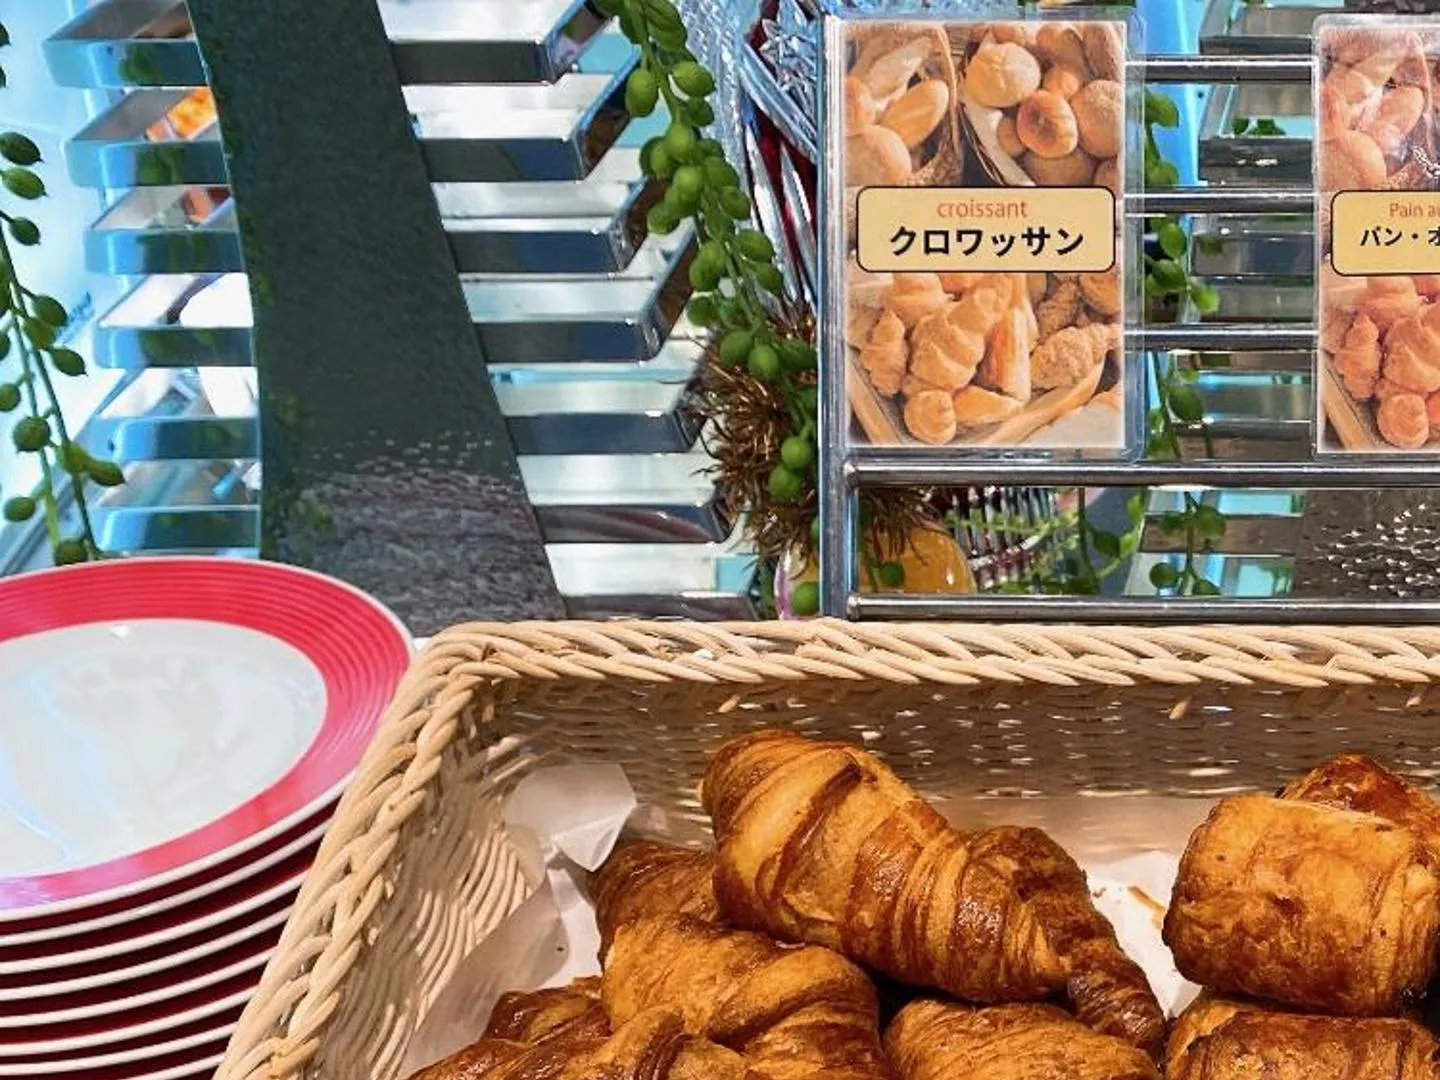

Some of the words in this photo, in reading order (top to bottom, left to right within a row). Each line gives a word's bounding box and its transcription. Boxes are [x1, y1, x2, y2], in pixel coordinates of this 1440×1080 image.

[937, 199, 1028, 218] croissant
[1389, 202, 1424, 218] Pain
[889, 226, 1085, 257] クロワッサン
